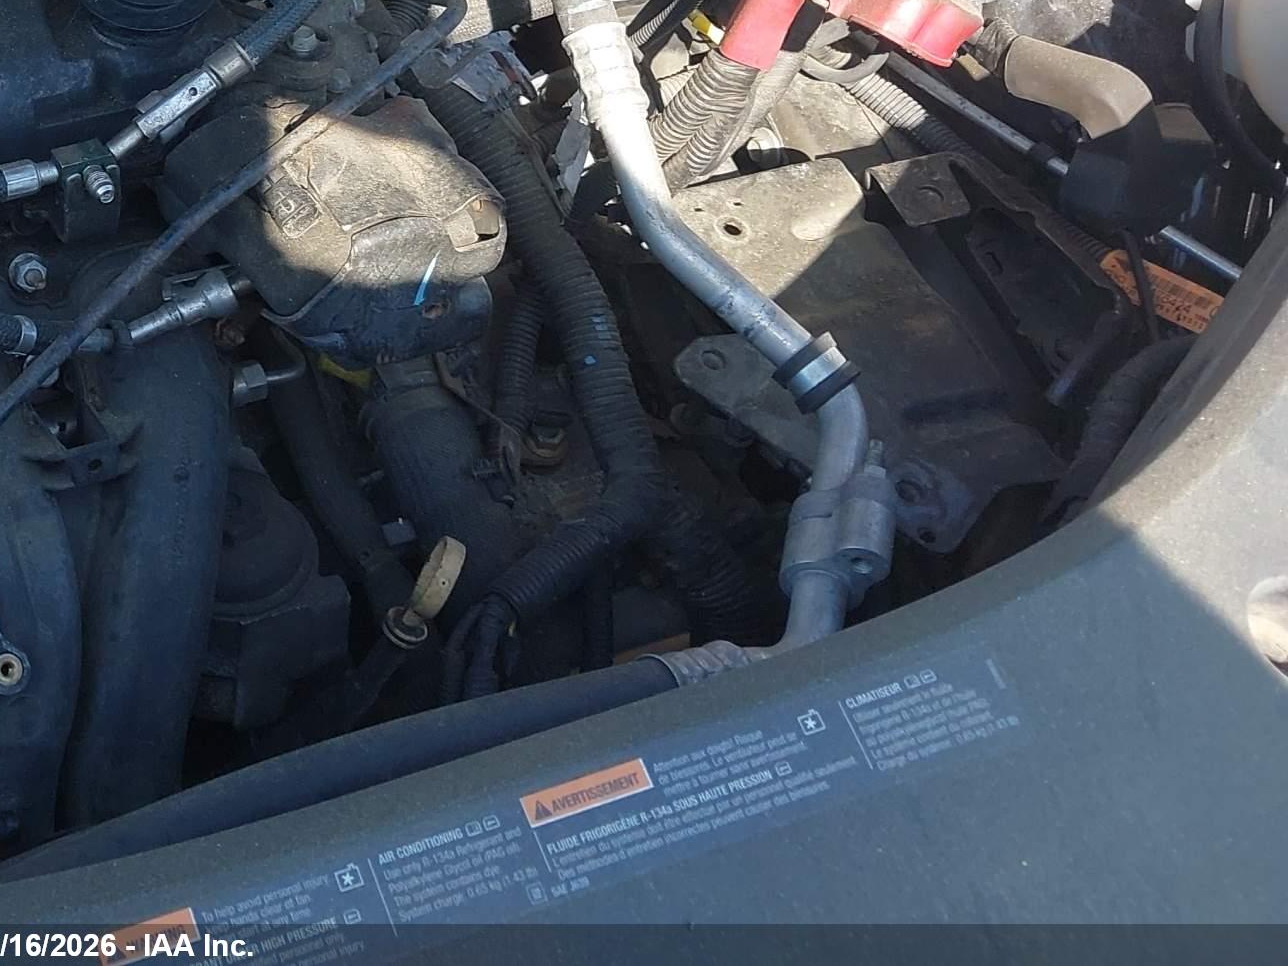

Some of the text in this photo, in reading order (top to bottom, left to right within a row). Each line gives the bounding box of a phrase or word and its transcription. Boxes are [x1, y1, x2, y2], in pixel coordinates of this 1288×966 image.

[846, 682, 902, 708] CLIMATISEUR
[550, 774, 640, 813] AVERTISSEMENT
[547, 835, 579, 854] FLUIDE
[640, 804, 672, 822] R-134a
[673, 795, 698, 811] SOUS
[698, 785, 727, 802] HAUTE
[728, 769, 772, 792] PRESSION
[378, 828, 463, 864] AIR CONDITIONING
[384, 827, 521, 879] Use only R-134a Refrigerant and
[395, 894, 411, 905] The
[489, 878, 502, 892] kg
[202, 910, 213, 922] To
[214, 904, 234, 918] help
[236, 895, 261, 911] avoid
[263, 883, 302, 903] personal
[260, 903, 282, 916] clear
[262, 935, 286, 951] HIGH
[287, 918, 337, 941] PRESSURE
